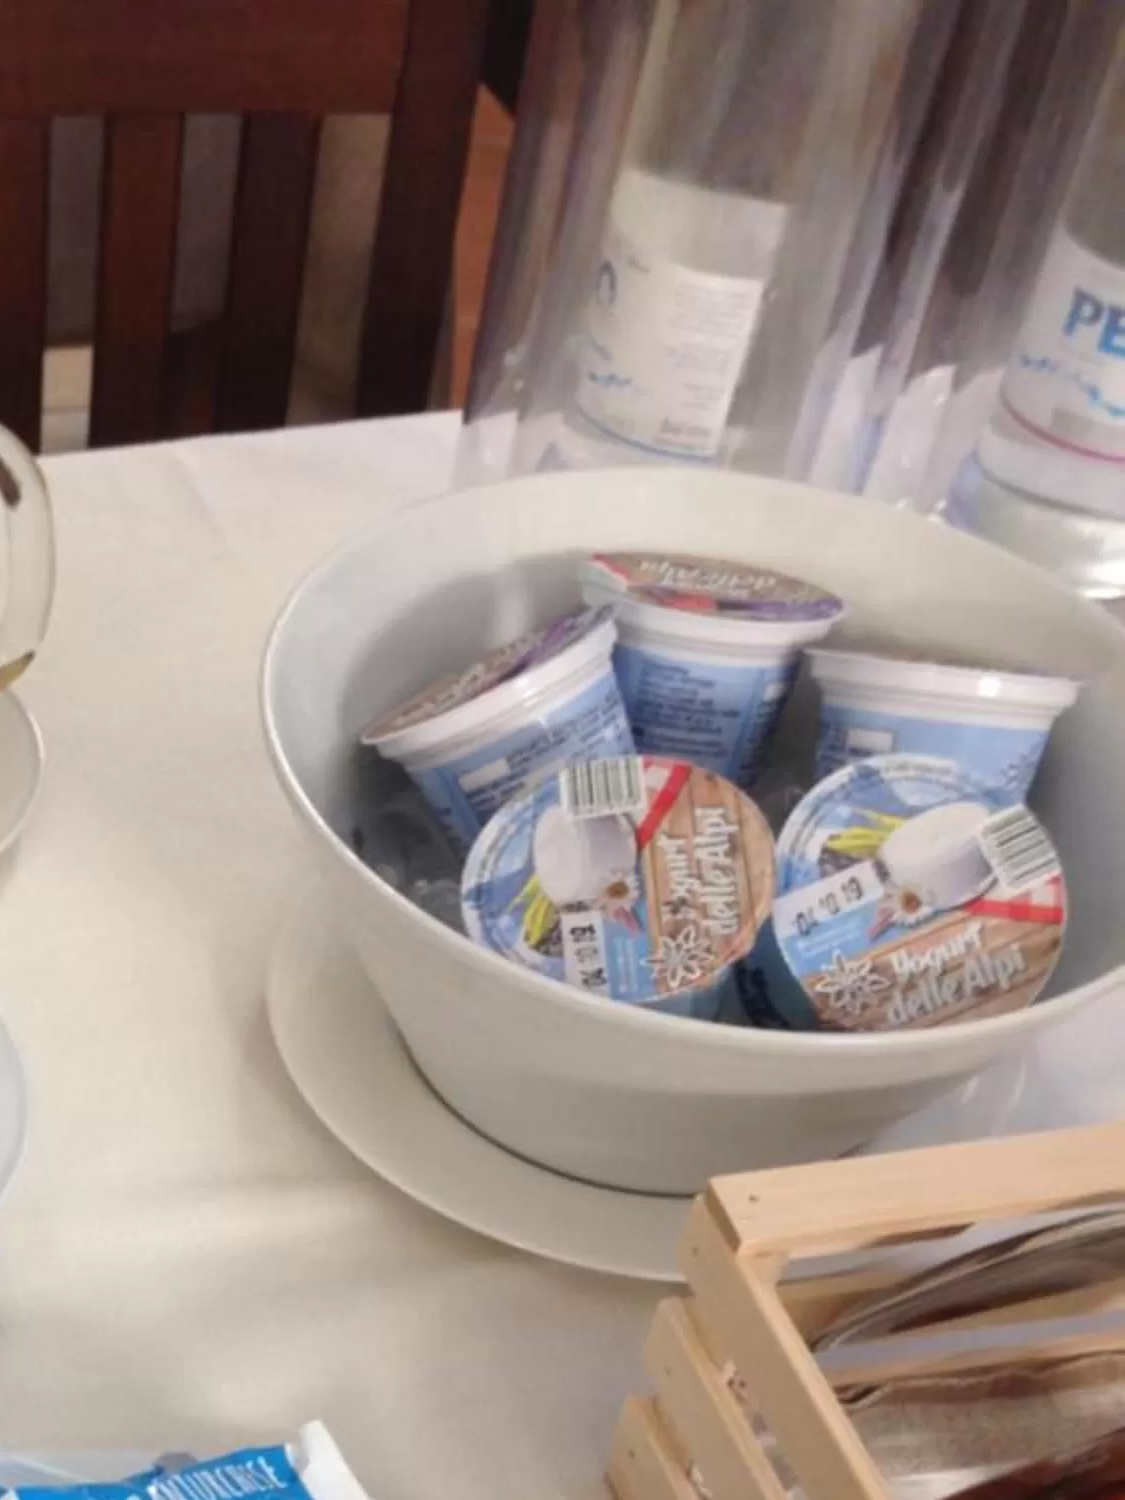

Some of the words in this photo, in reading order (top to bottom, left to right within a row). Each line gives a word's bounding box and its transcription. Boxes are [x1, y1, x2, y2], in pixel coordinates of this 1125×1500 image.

[1060, 284, 1125, 357] PE
[694, 807, 741, 864] Alpi
[696, 869, 741, 935] delle
[957, 941, 1025, 1001] Alpi
